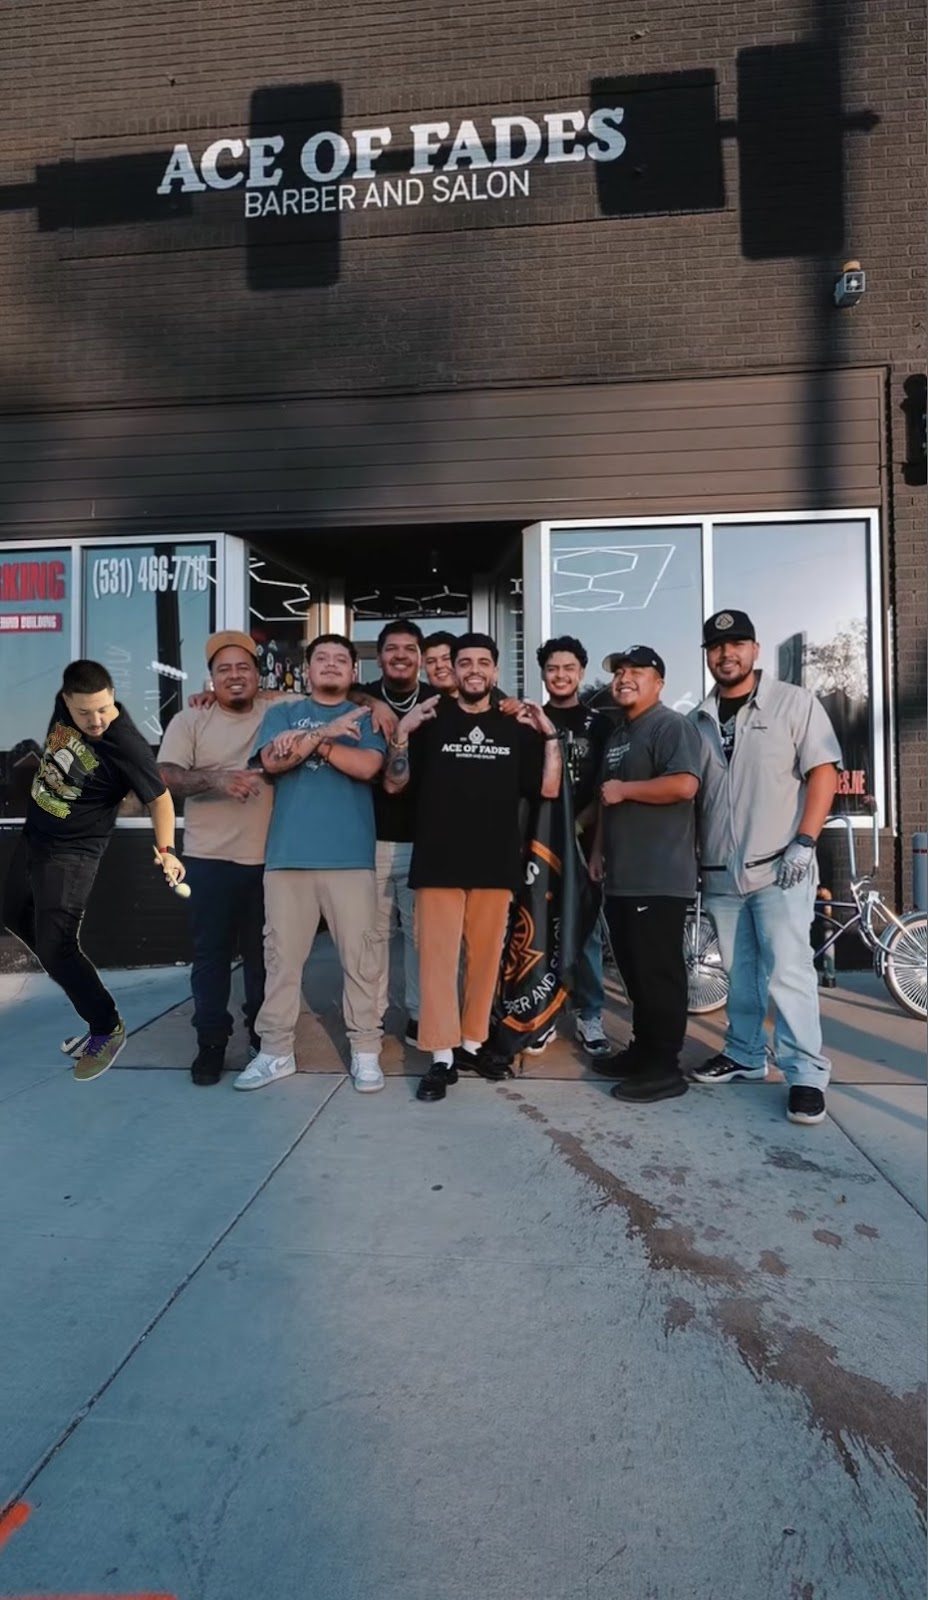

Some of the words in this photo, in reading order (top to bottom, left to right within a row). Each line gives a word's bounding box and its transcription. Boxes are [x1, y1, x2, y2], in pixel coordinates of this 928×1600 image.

[156, 135, 285, 195] ACE
[300, 126, 392, 183] OF
[409, 106, 627, 175] FADES
[244, 183, 356, 218] BARBER
[362, 177, 424, 209] AND
[432, 169, 530, 203] SALON
[0, 560, 65, 602] KING
[92, 556, 133, 599] (531)
[137, 554, 208, 593] 466-7719
[441, 743, 463, 752] ACE
[463, 743, 478, 753] OF
[479, 745, 511, 755] FADES
[532, 971, 557, 1006] AND
